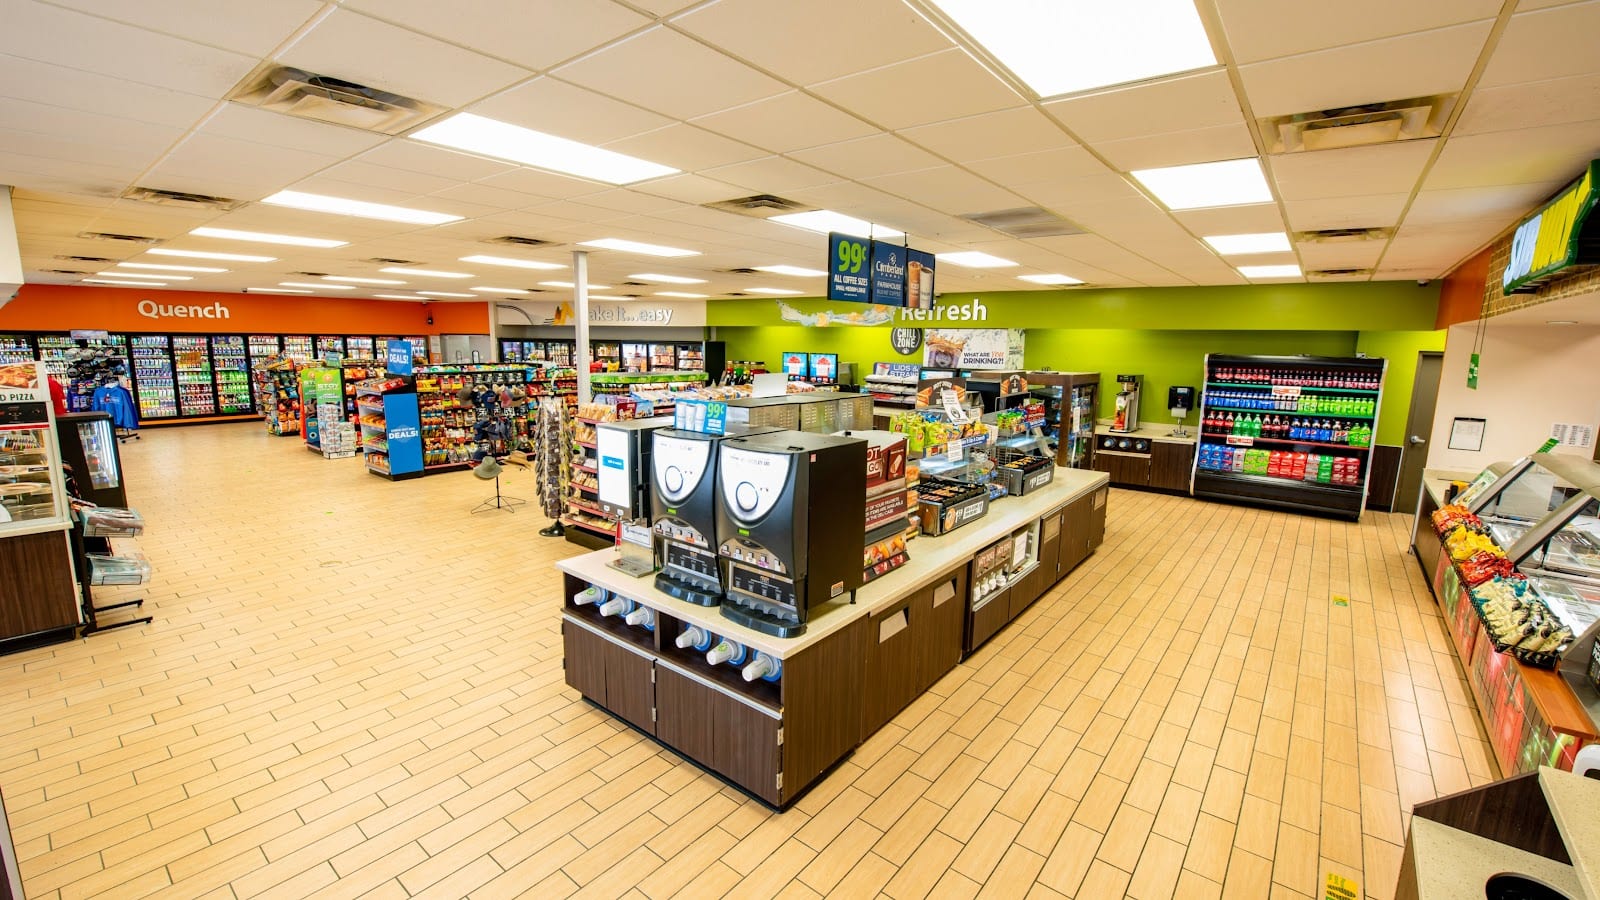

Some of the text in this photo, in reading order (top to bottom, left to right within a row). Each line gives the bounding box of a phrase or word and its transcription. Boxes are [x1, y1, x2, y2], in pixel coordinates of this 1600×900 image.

[876, 260, 904, 276] Cumberland
[834, 274, 868, 286] ALL COFFEE SIZES
[137, 299, 230, 319] Quench
[901, 298, 987, 321] Refresh
[897, 328, 917, 339] CHILL
[897, 339, 916, 348] ZONE
[389, 353, 409, 364] DEALS!
[893, 364, 911, 372] LIDS
[10, 393, 35, 401] PIZZA
[389, 430, 419, 439] DEALS!
